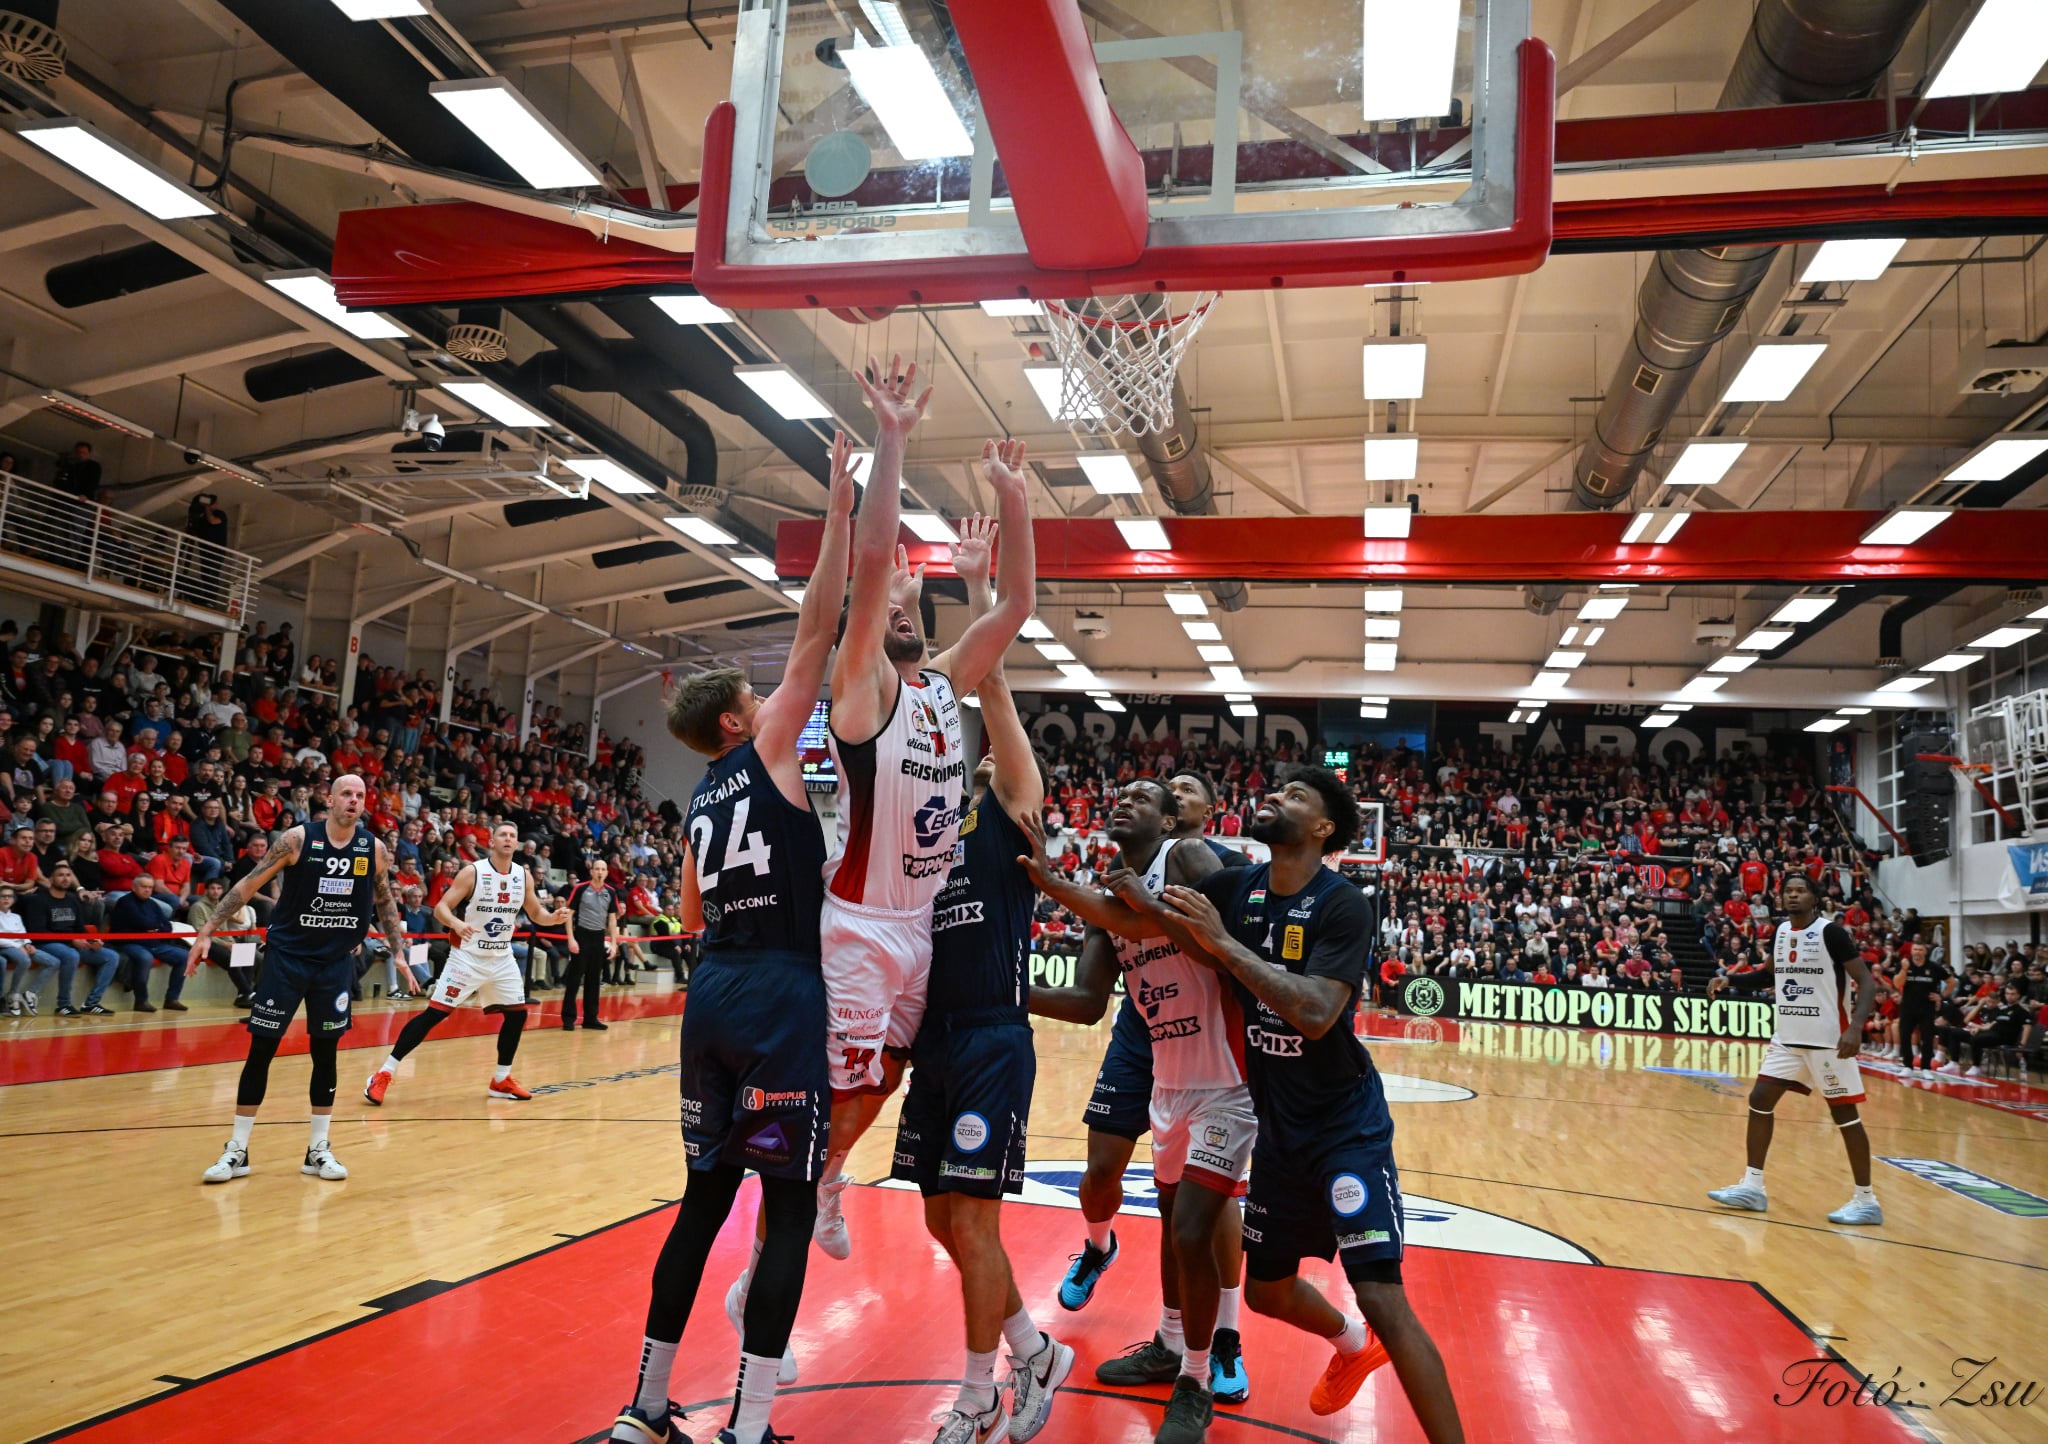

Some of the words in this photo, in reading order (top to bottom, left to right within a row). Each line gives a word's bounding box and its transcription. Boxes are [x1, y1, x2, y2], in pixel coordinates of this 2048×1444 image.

[350, 637, 359, 653] B
[447, 666, 454, 681] C
[526, 690, 533, 703] C
[594, 711, 600, 723] C
[690, 797, 771, 895] 24
[326, 857, 351, 875] 99
[724, 894, 778, 914] AICONIC
[1789, 986, 1815, 995] EGIS
[1458, 982, 1663, 1031] METROPOLIS
[681, 1096, 702, 1113] ence
